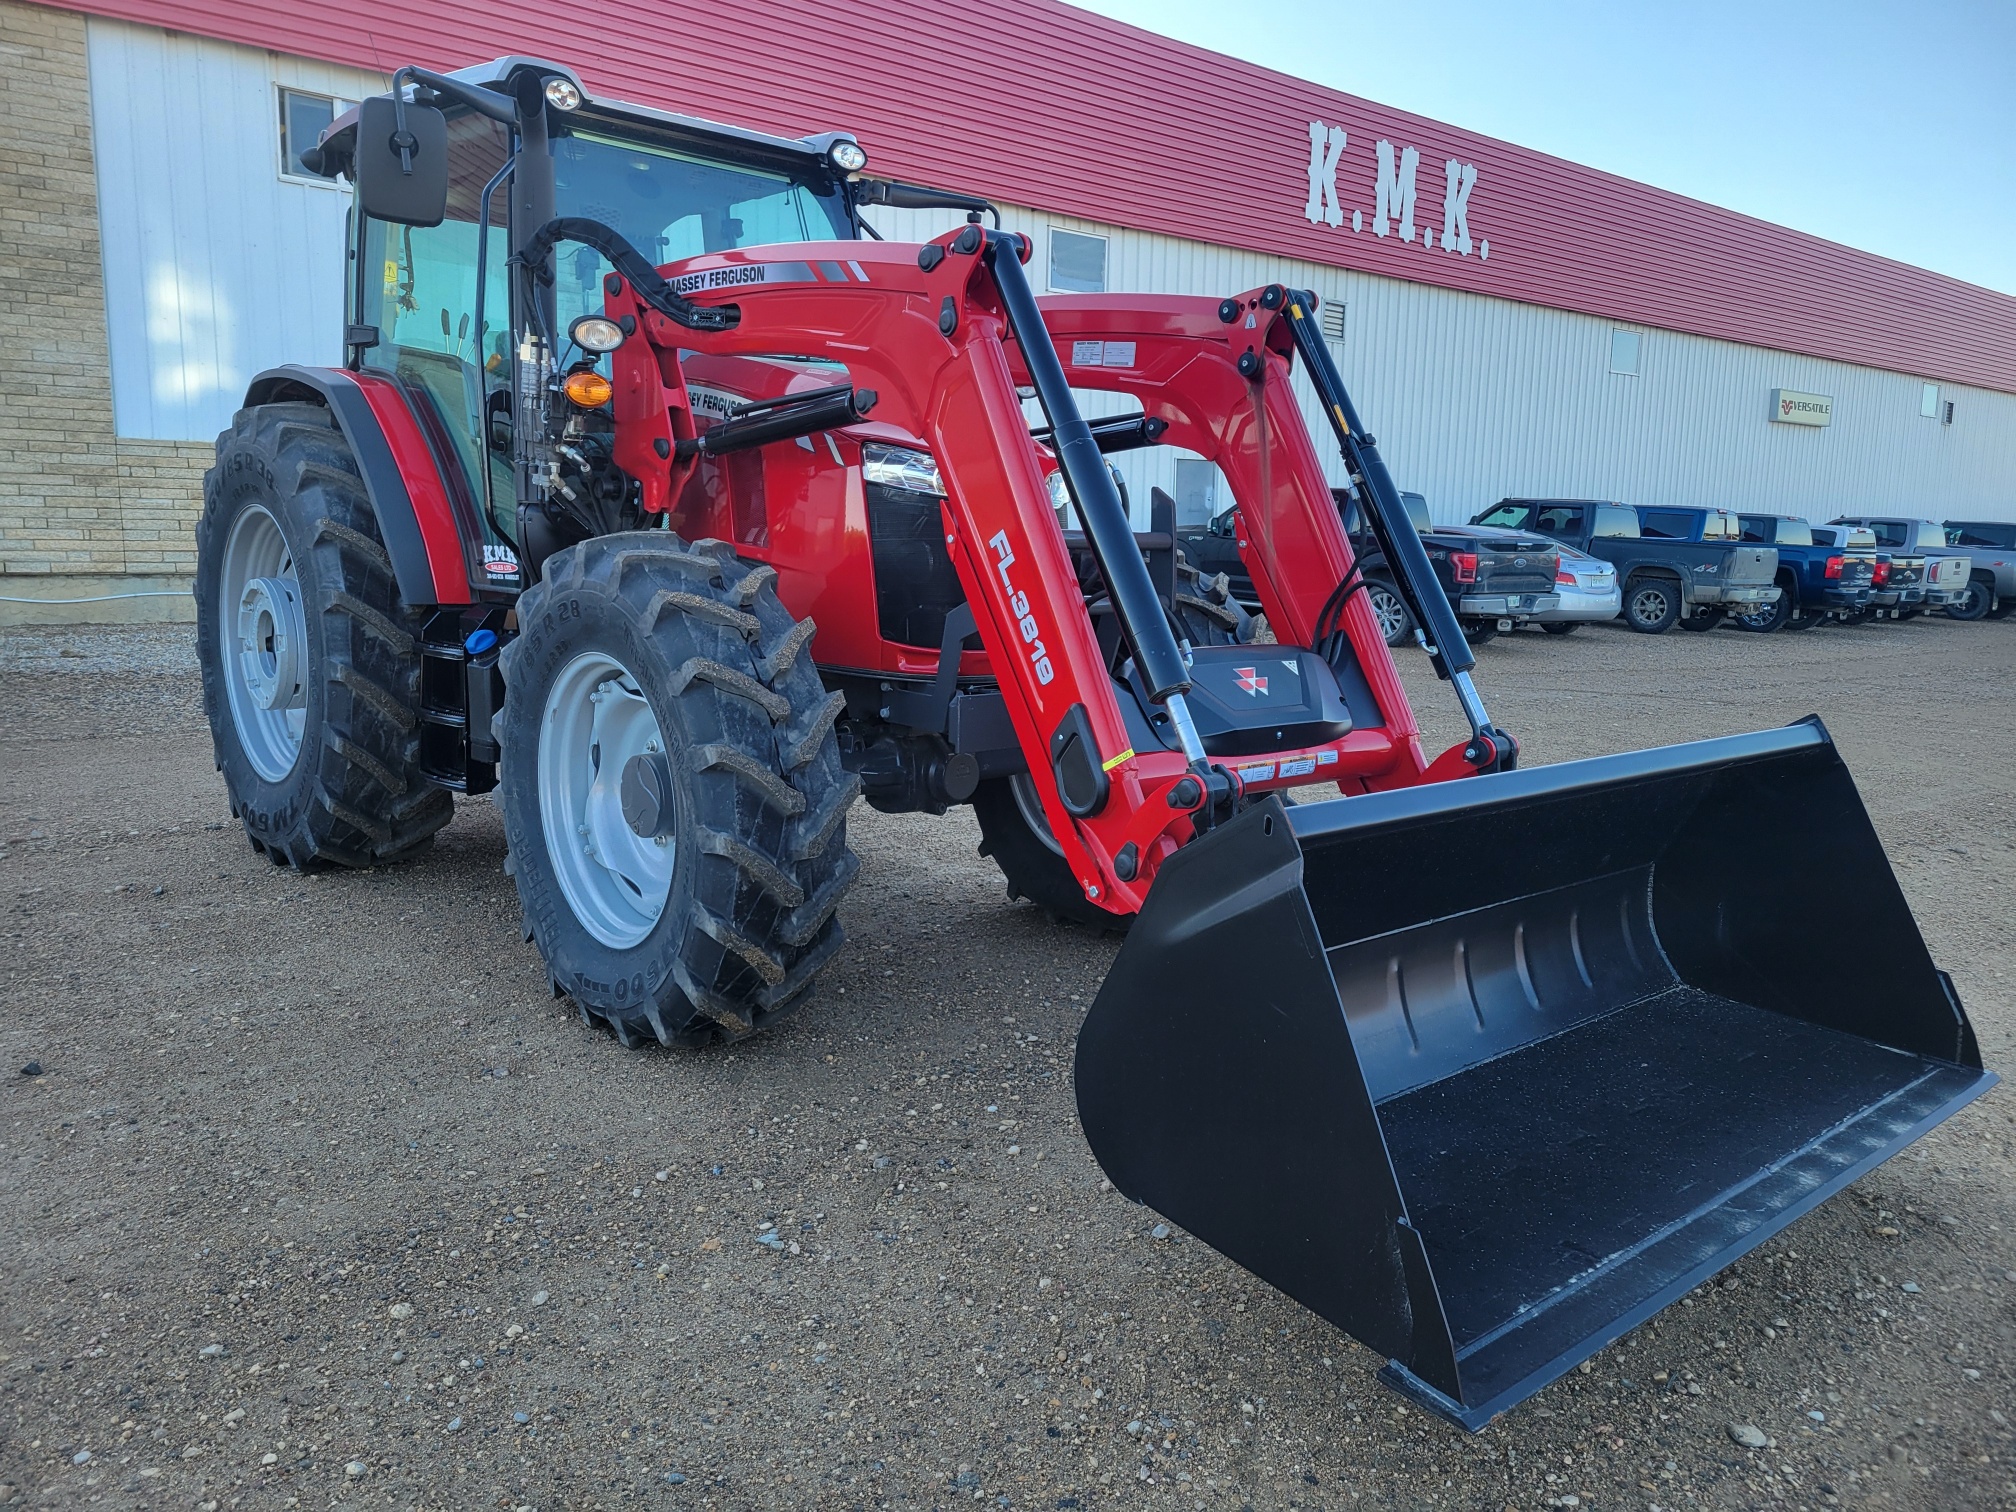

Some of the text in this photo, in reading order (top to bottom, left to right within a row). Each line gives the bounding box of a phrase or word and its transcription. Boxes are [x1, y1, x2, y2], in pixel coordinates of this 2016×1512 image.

[1305, 120, 1489, 260] K.M.K.
[709, 265, 765, 287] FERGUSON
[1793, 401, 1830, 414] VERSATILE
[989, 529, 1054, 686] FL.3819
